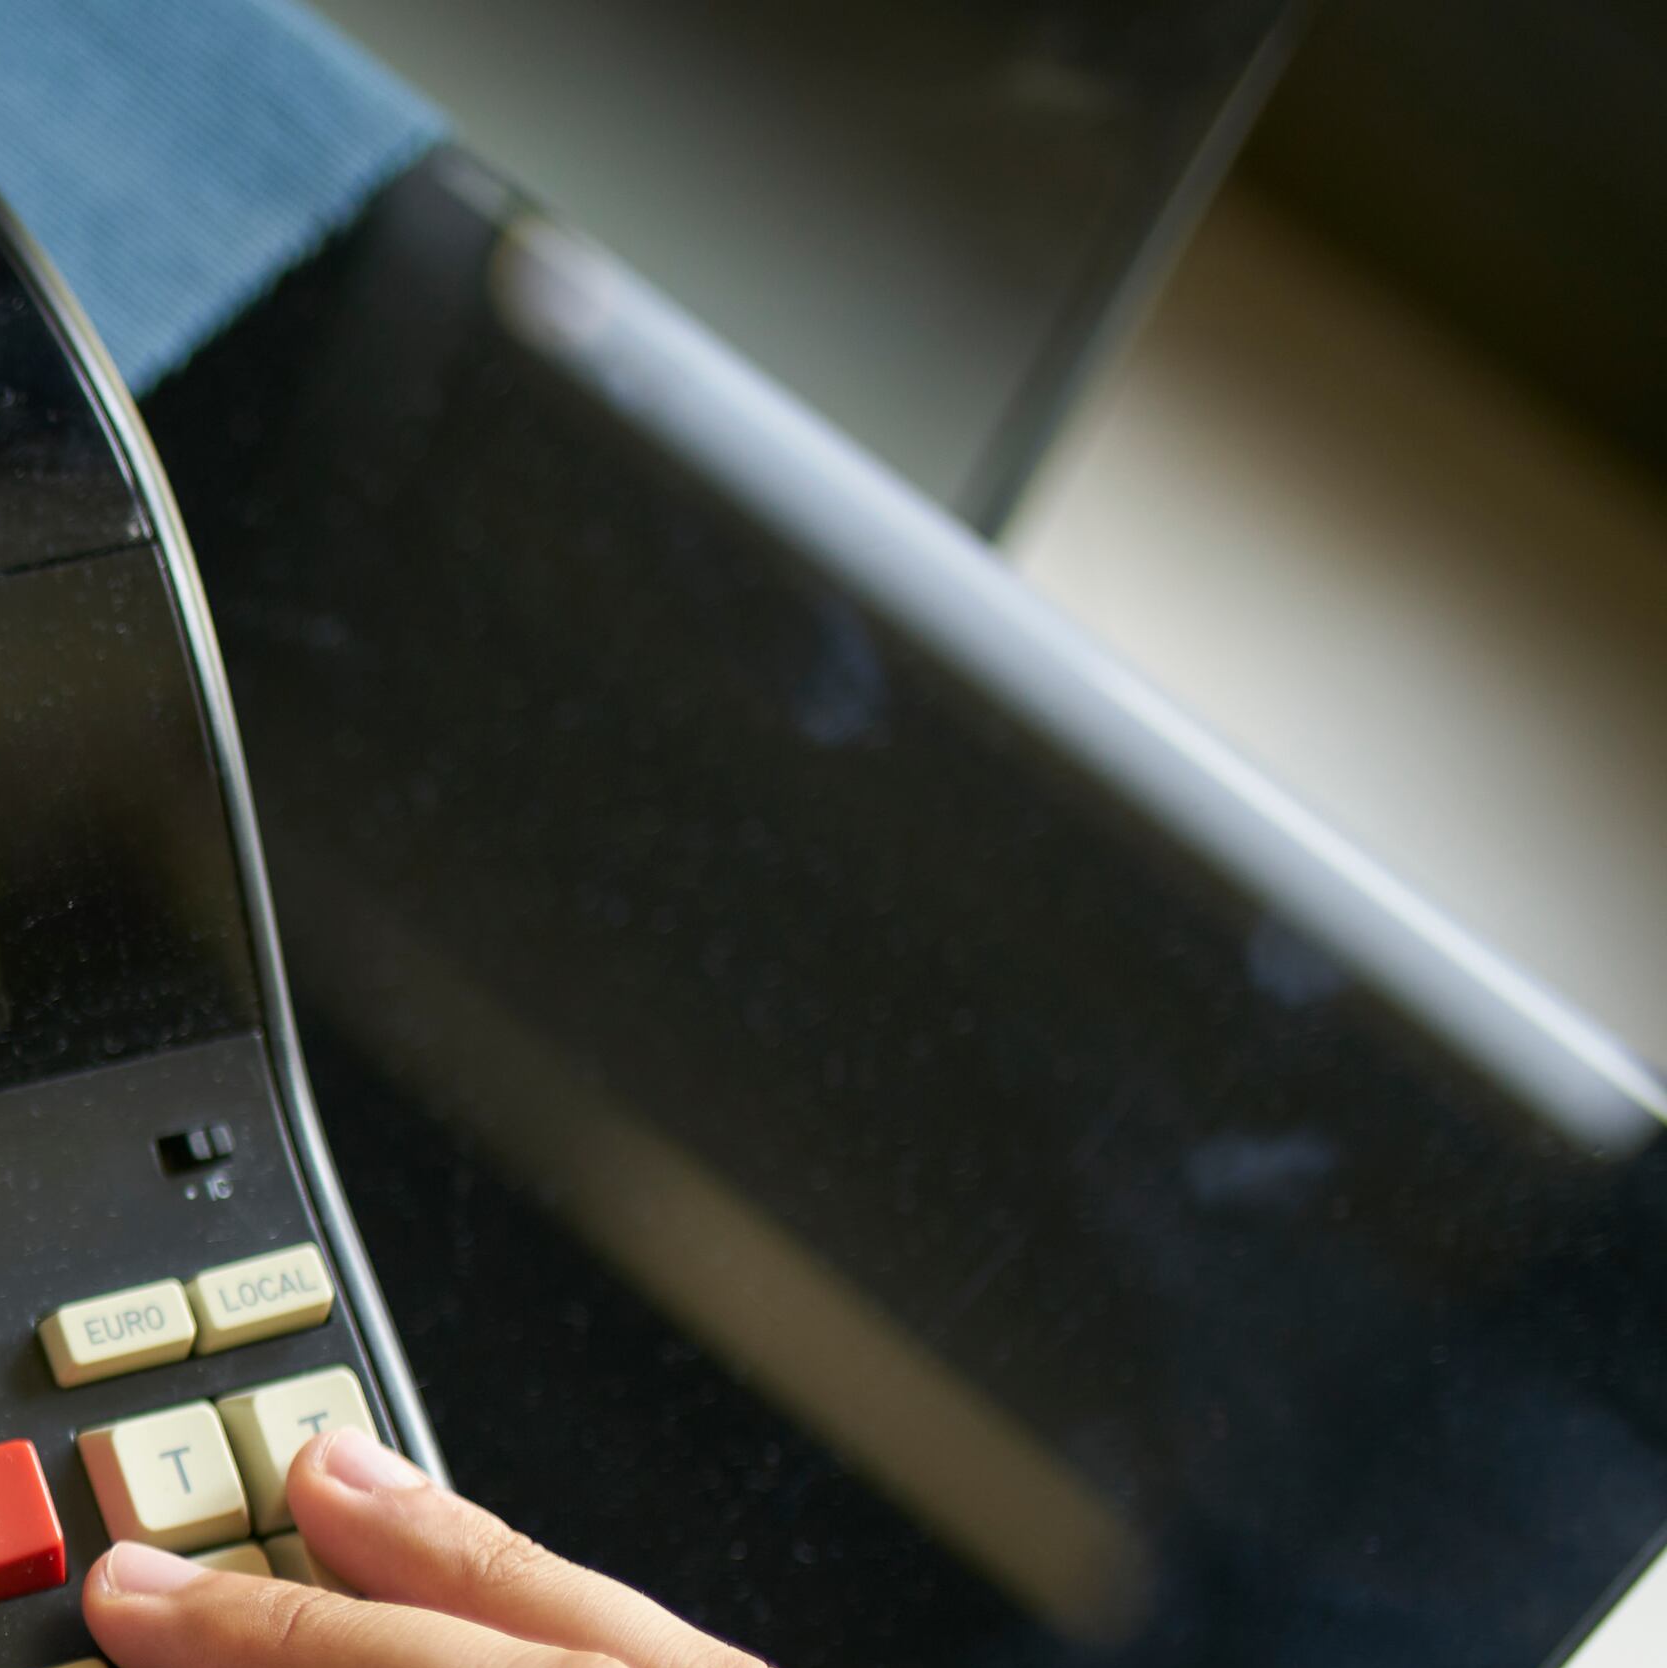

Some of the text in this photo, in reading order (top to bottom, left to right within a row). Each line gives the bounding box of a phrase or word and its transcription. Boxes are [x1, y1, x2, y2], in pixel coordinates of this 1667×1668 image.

[218, 1266, 319, 1314] LOCAL
[83, 1306, 166, 1347] EURO
[159, 1447, 192, 1494] T
